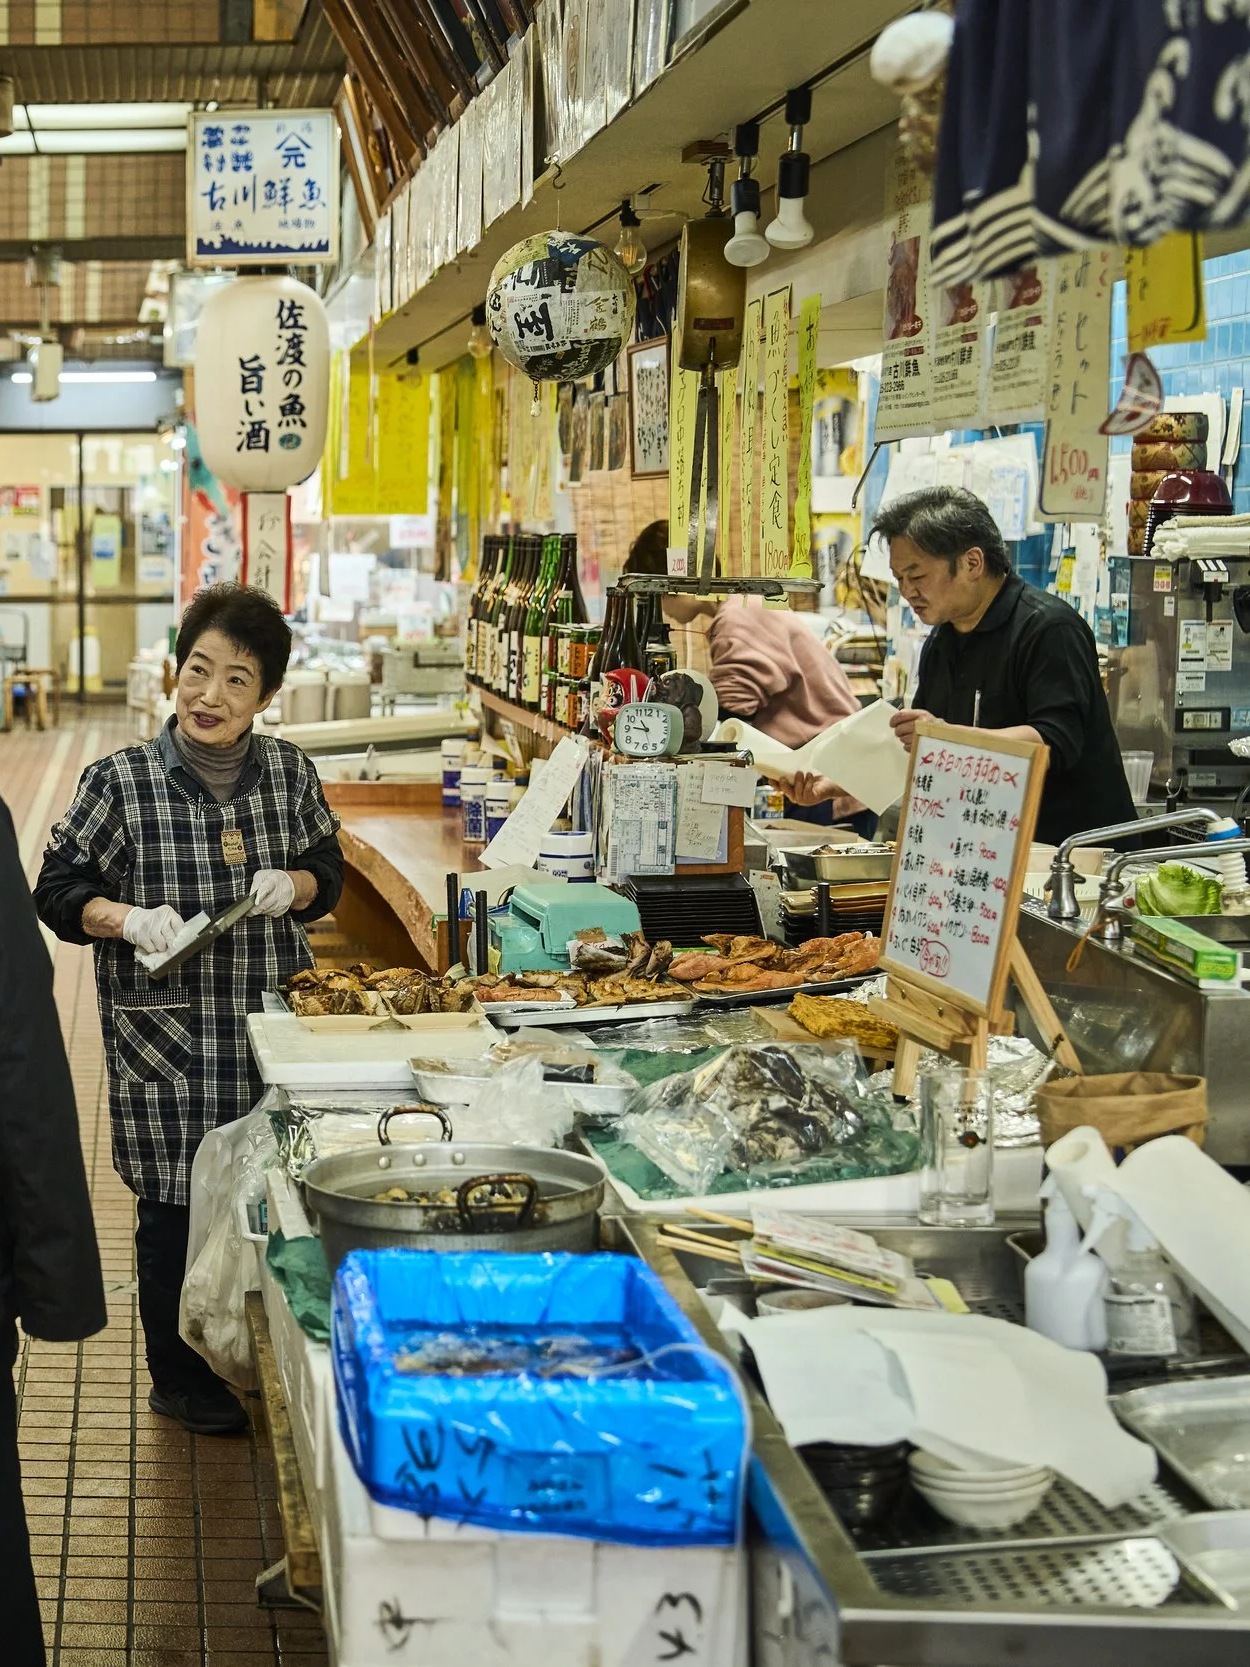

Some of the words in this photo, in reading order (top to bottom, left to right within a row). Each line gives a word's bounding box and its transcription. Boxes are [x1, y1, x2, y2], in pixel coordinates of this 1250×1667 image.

[201, 173, 327, 214] 古川鮮魚
[275, 299, 308, 429] 佐渡の魚
[237, 354, 270, 453] 旨い酒
[635, 709, 642, 717] 11
[643, 709, 654, 717] 12
[656, 710, 660, 718] 1
[626, 715, 636, 723] 10
[624, 725, 631, 733] 9
[625, 736, 632, 744] 8
[634, 742, 640, 750] 7
[642, 743, 648, 751] 6
[651, 743, 658, 751] 5
[935, 749, 1000, 785] 本日のおすすめ
